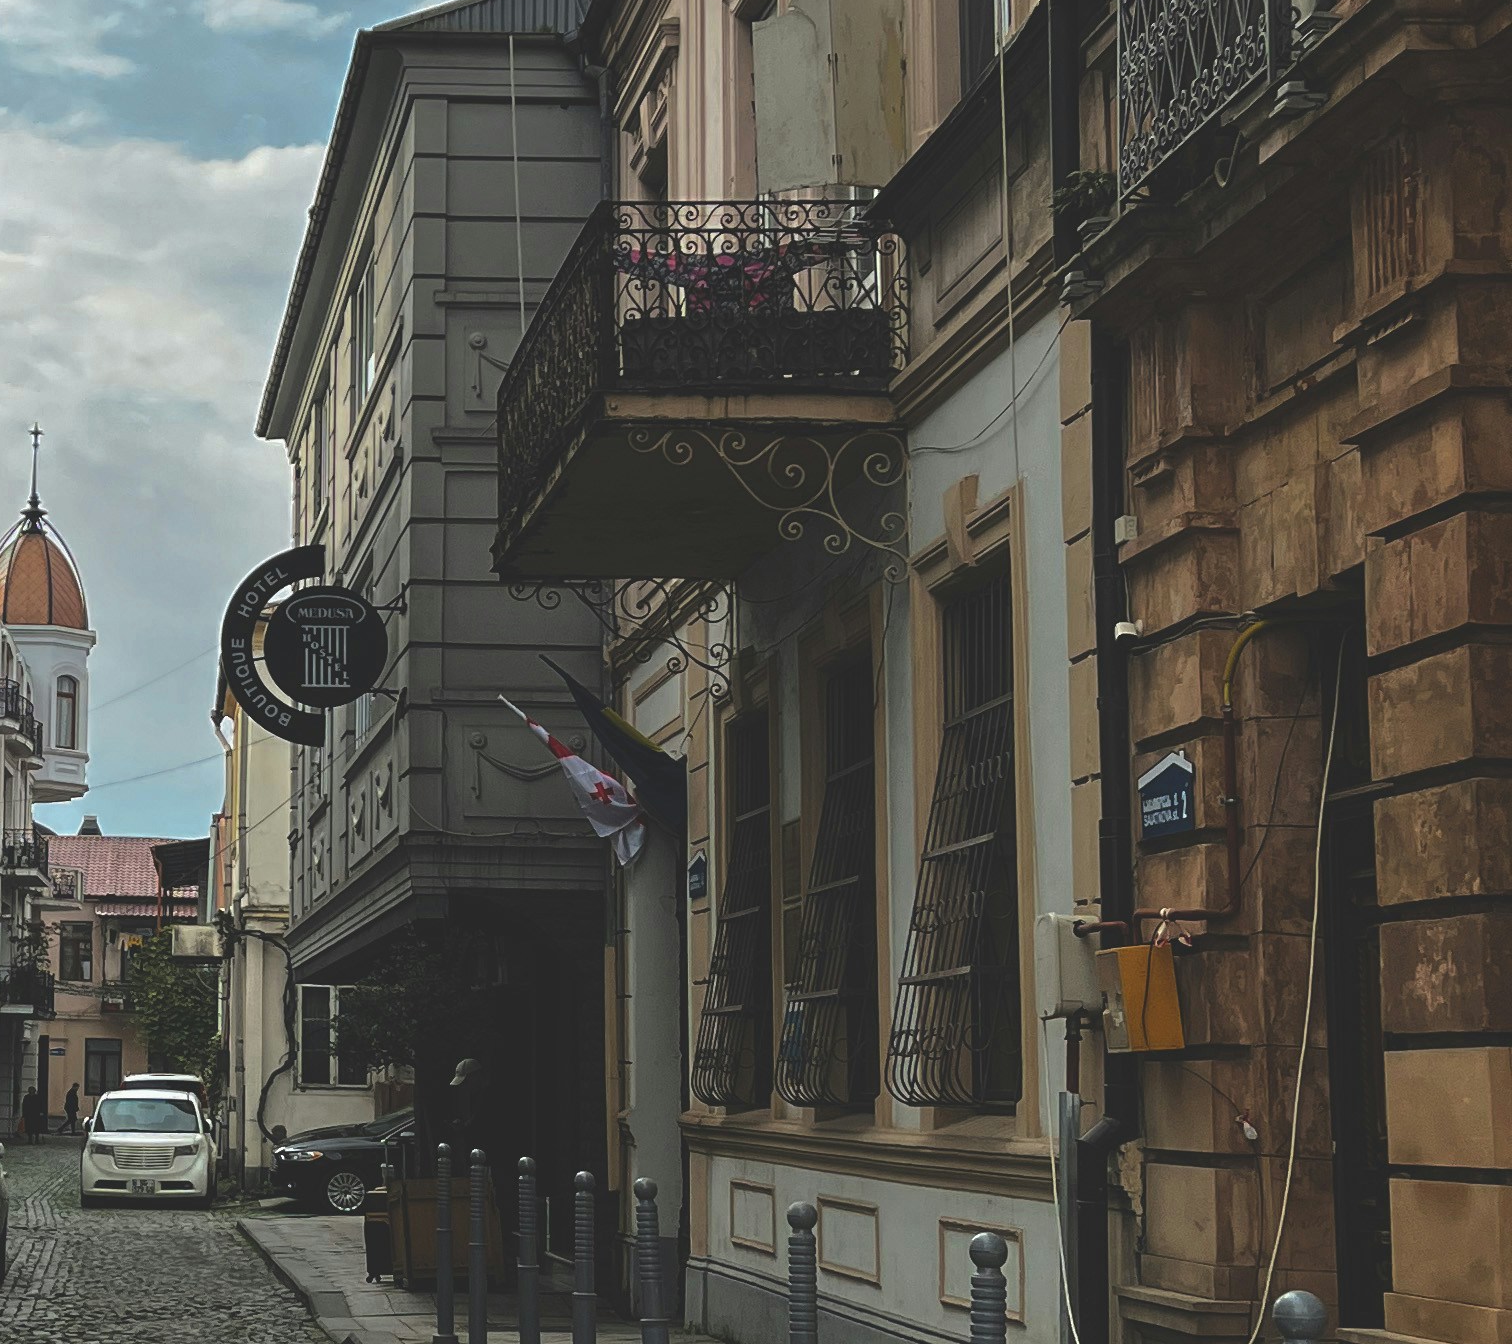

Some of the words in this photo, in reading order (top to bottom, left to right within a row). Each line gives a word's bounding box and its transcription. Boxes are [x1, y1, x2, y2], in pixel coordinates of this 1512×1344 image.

[237, 567, 289, 618] HOTEL
[297, 607, 355, 619] MEDUSA
[302, 633, 350, 679] HOSTEL
[231, 637, 292, 727] BOUTIQUE
